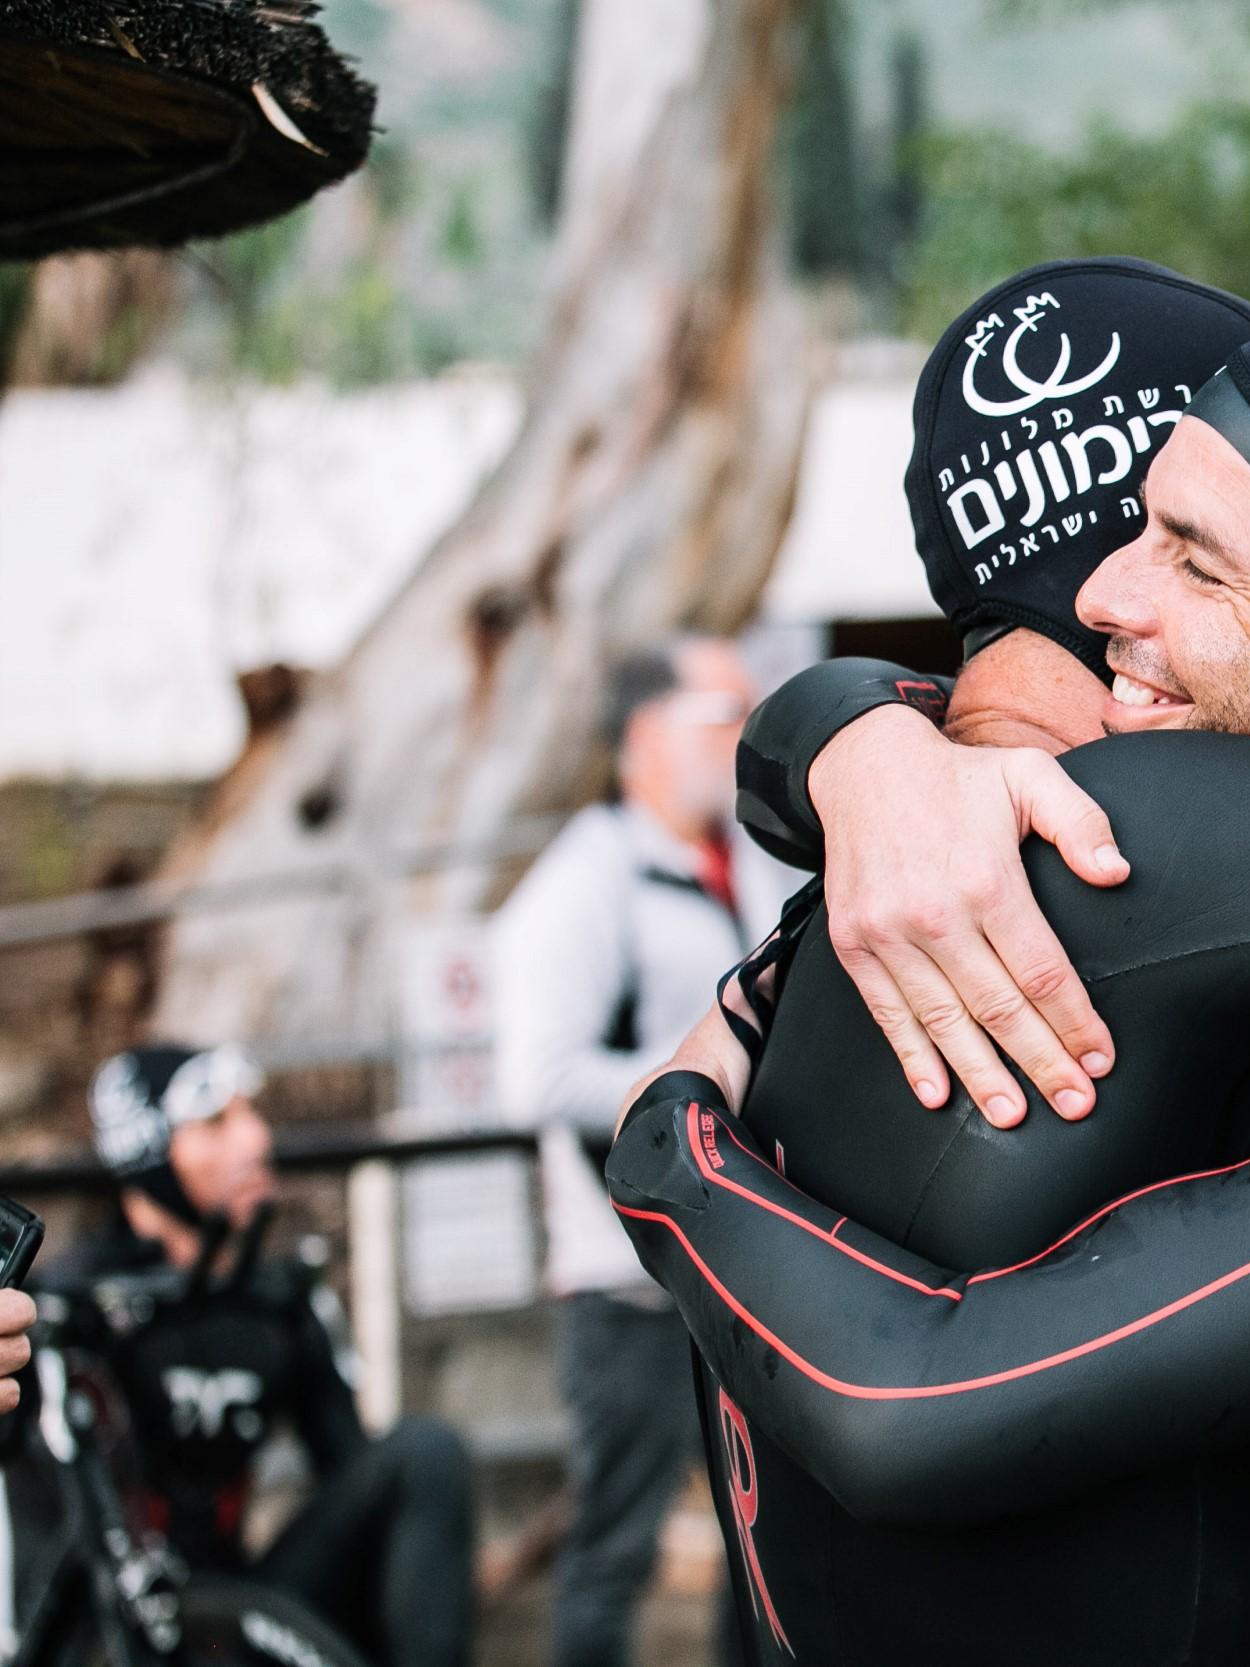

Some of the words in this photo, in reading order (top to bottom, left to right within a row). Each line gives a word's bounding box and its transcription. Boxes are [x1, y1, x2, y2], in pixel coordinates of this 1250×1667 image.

[1102, 383, 1192, 417] רשת
[937, 407, 1074, 492] מלונות
[973, 509, 1098, 585] ישראלית
